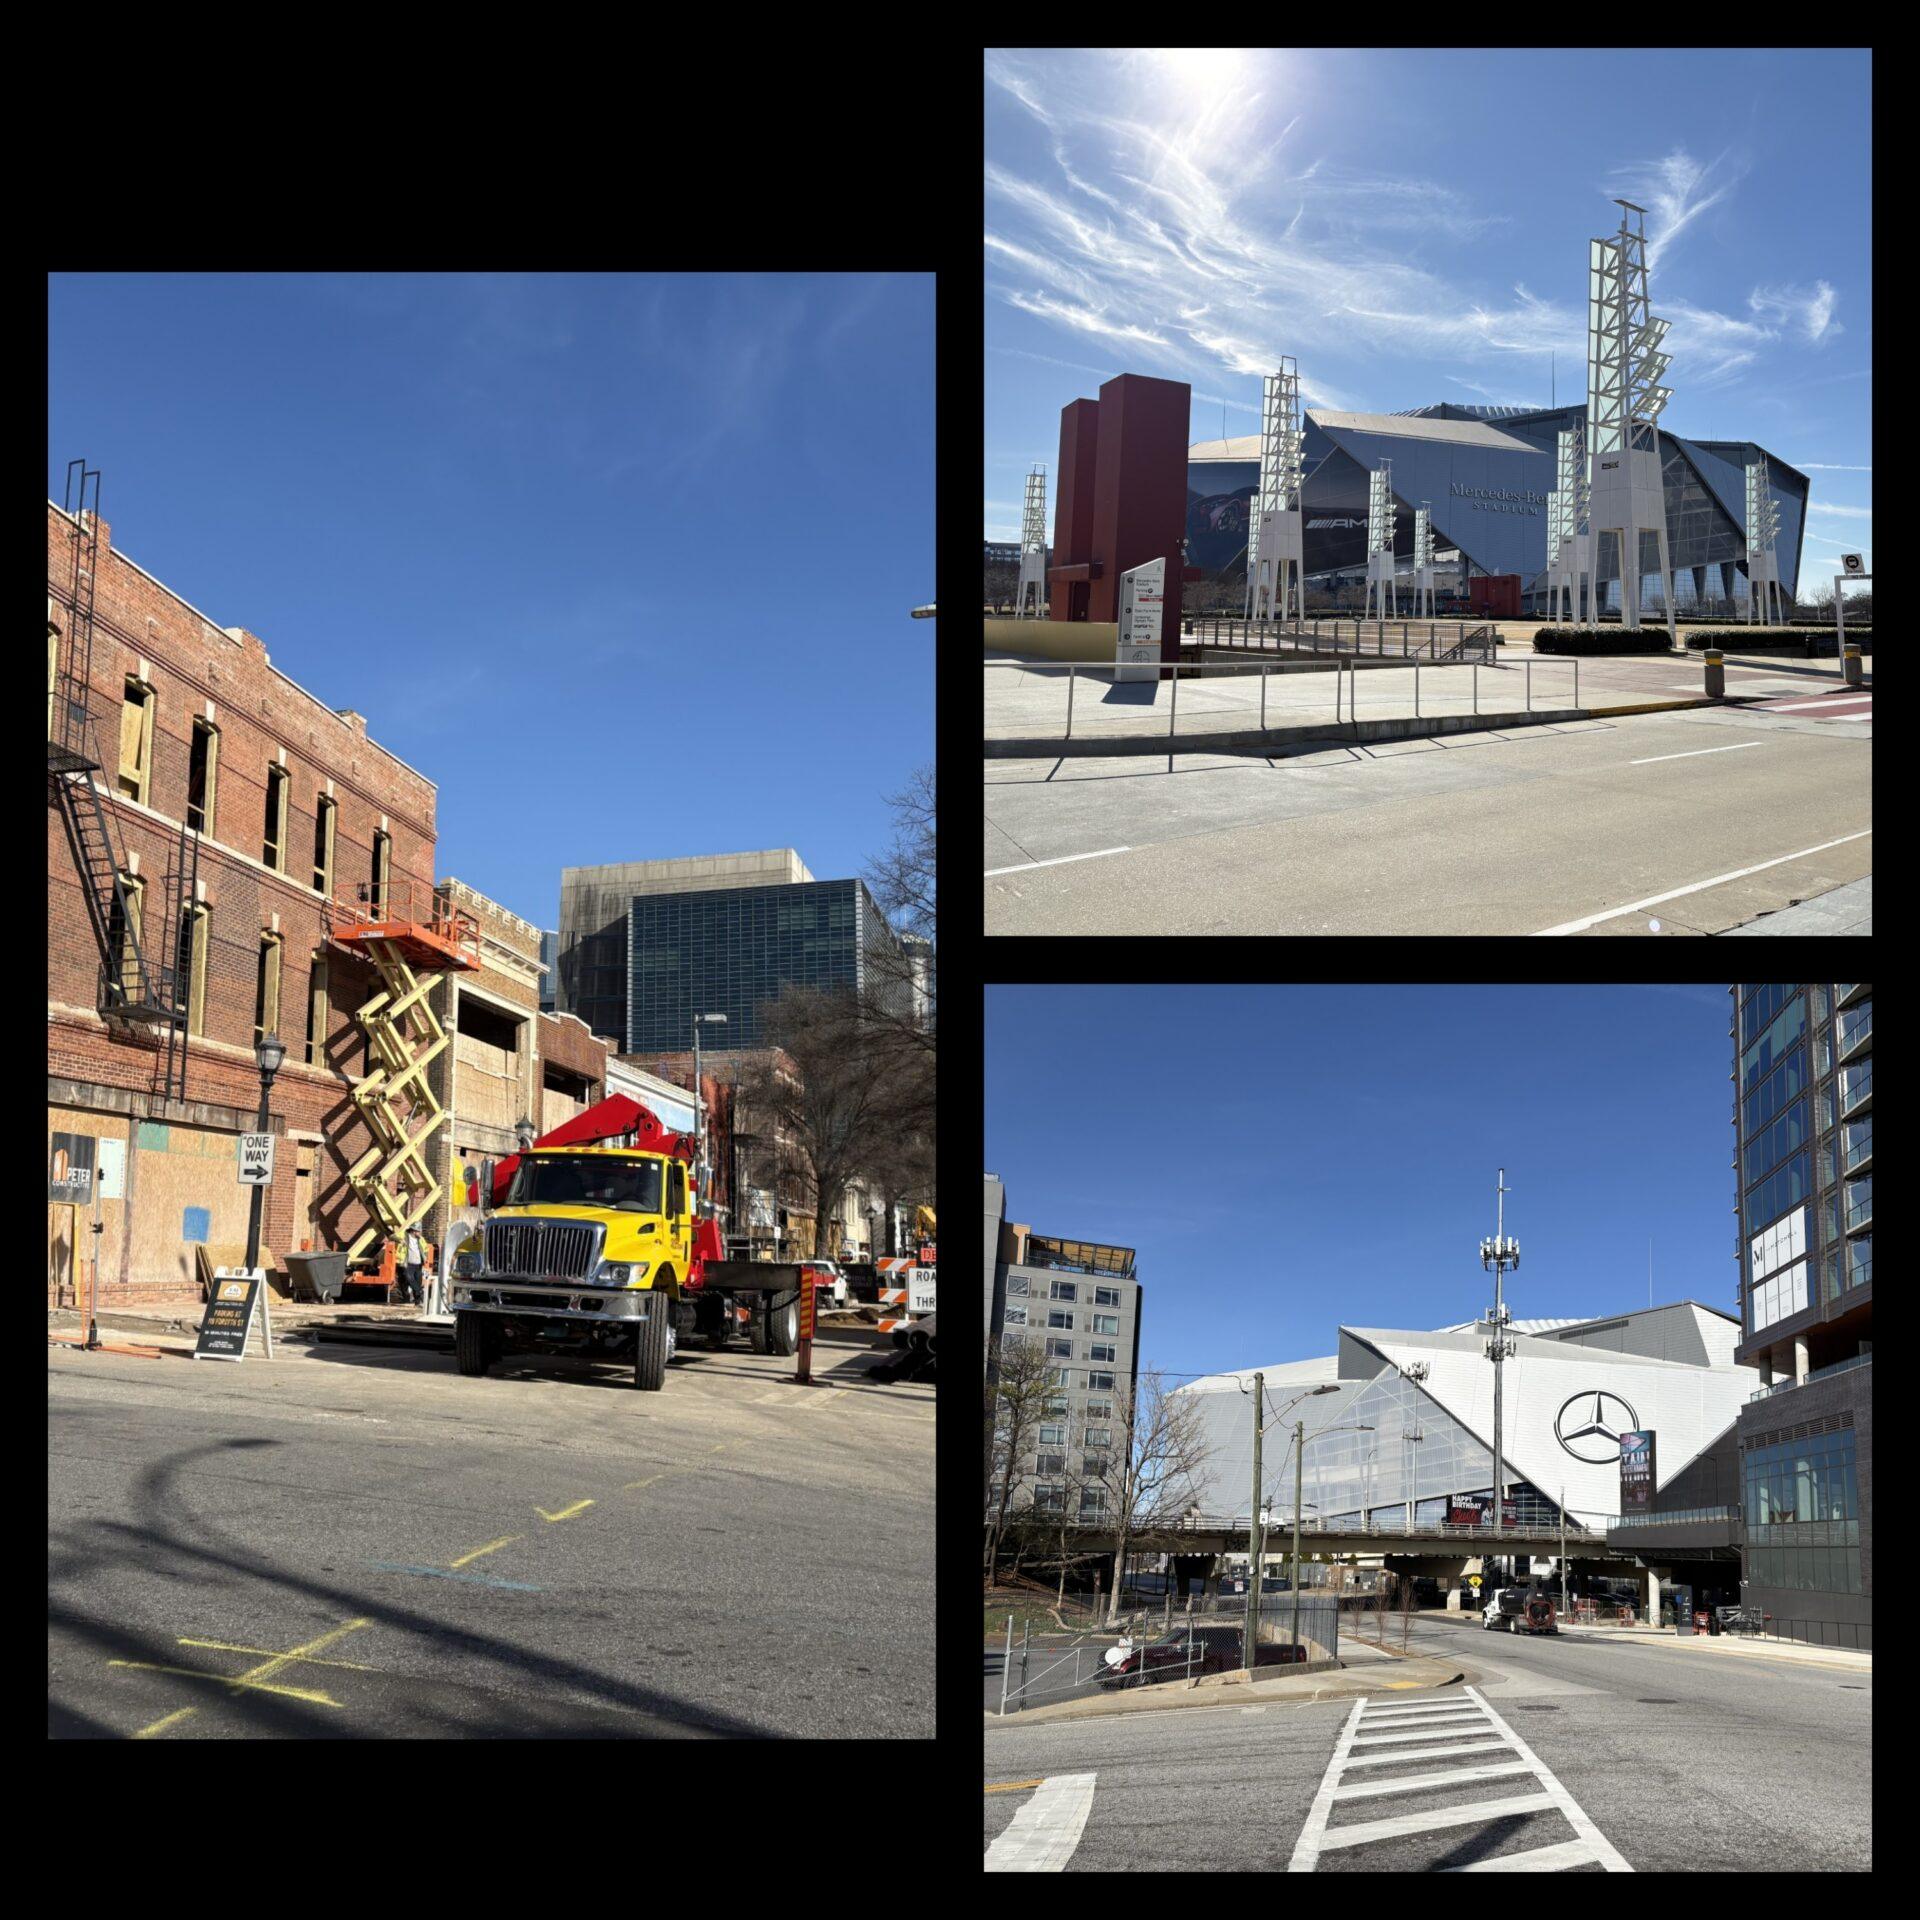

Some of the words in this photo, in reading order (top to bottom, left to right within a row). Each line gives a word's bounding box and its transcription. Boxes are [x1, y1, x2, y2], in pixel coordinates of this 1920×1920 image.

[1450, 482, 1548, 505] Mercedes-Be
[1473, 501, 1538, 515] STADIUM
[1328, 518, 1368, 528] AM
[246, 1136, 269, 1148] ONE
[245, 1150, 268, 1162] WAY
[67, 1167, 91, 1182] PETER
[1452, 1494, 1473, 1502] HAPPY
[1452, 1501, 1482, 1510] BIRTHDAY
